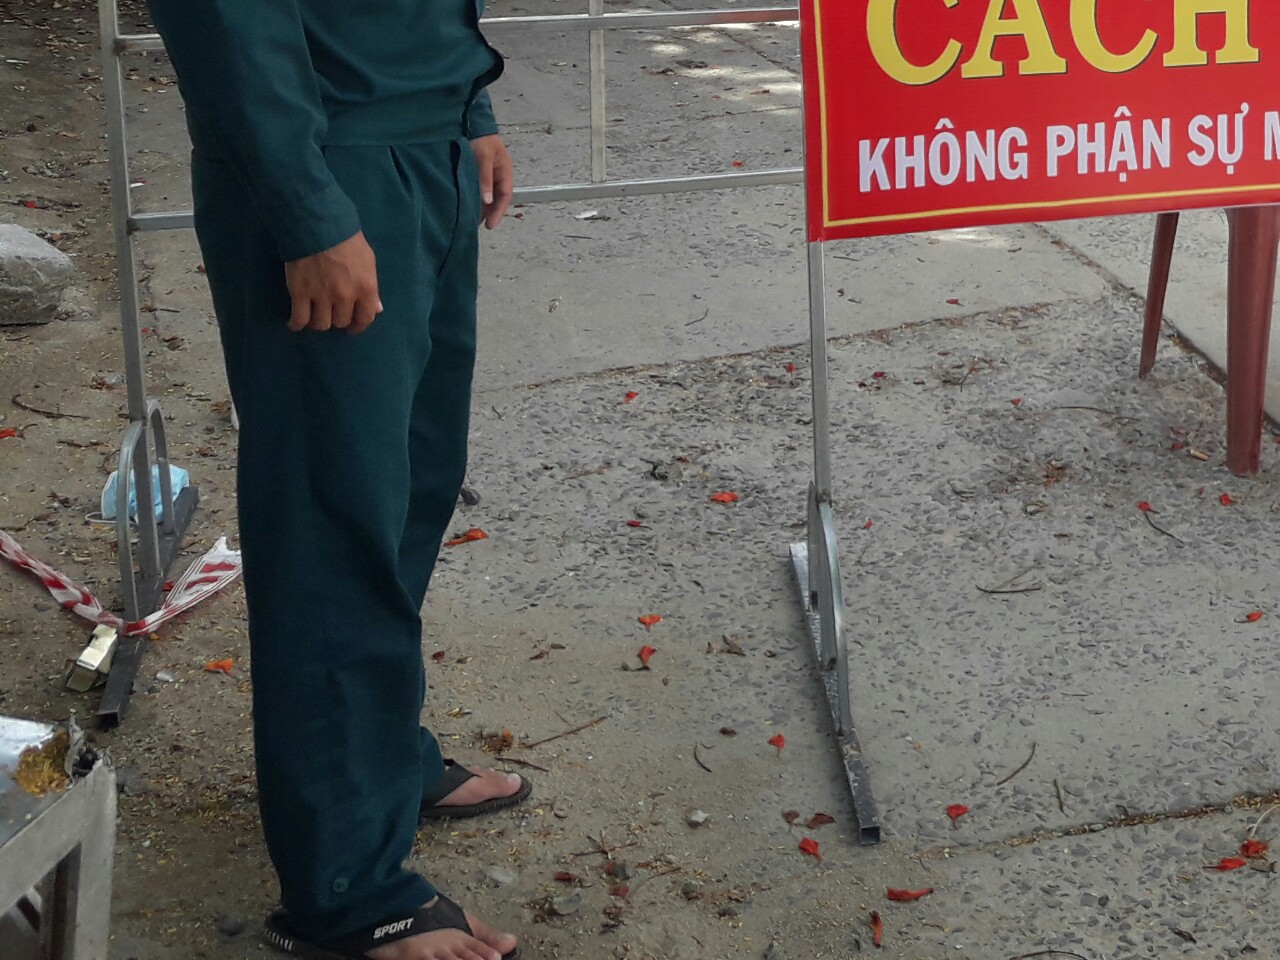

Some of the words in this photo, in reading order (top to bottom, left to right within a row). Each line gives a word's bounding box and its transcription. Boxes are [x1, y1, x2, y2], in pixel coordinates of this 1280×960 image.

[859, 118, 1029, 193] KHÔNG
[1047, 106, 1171, 183] PHẬN
[1187, 102, 1250, 175] SỰ
[373, 917, 414, 940] SPORT
